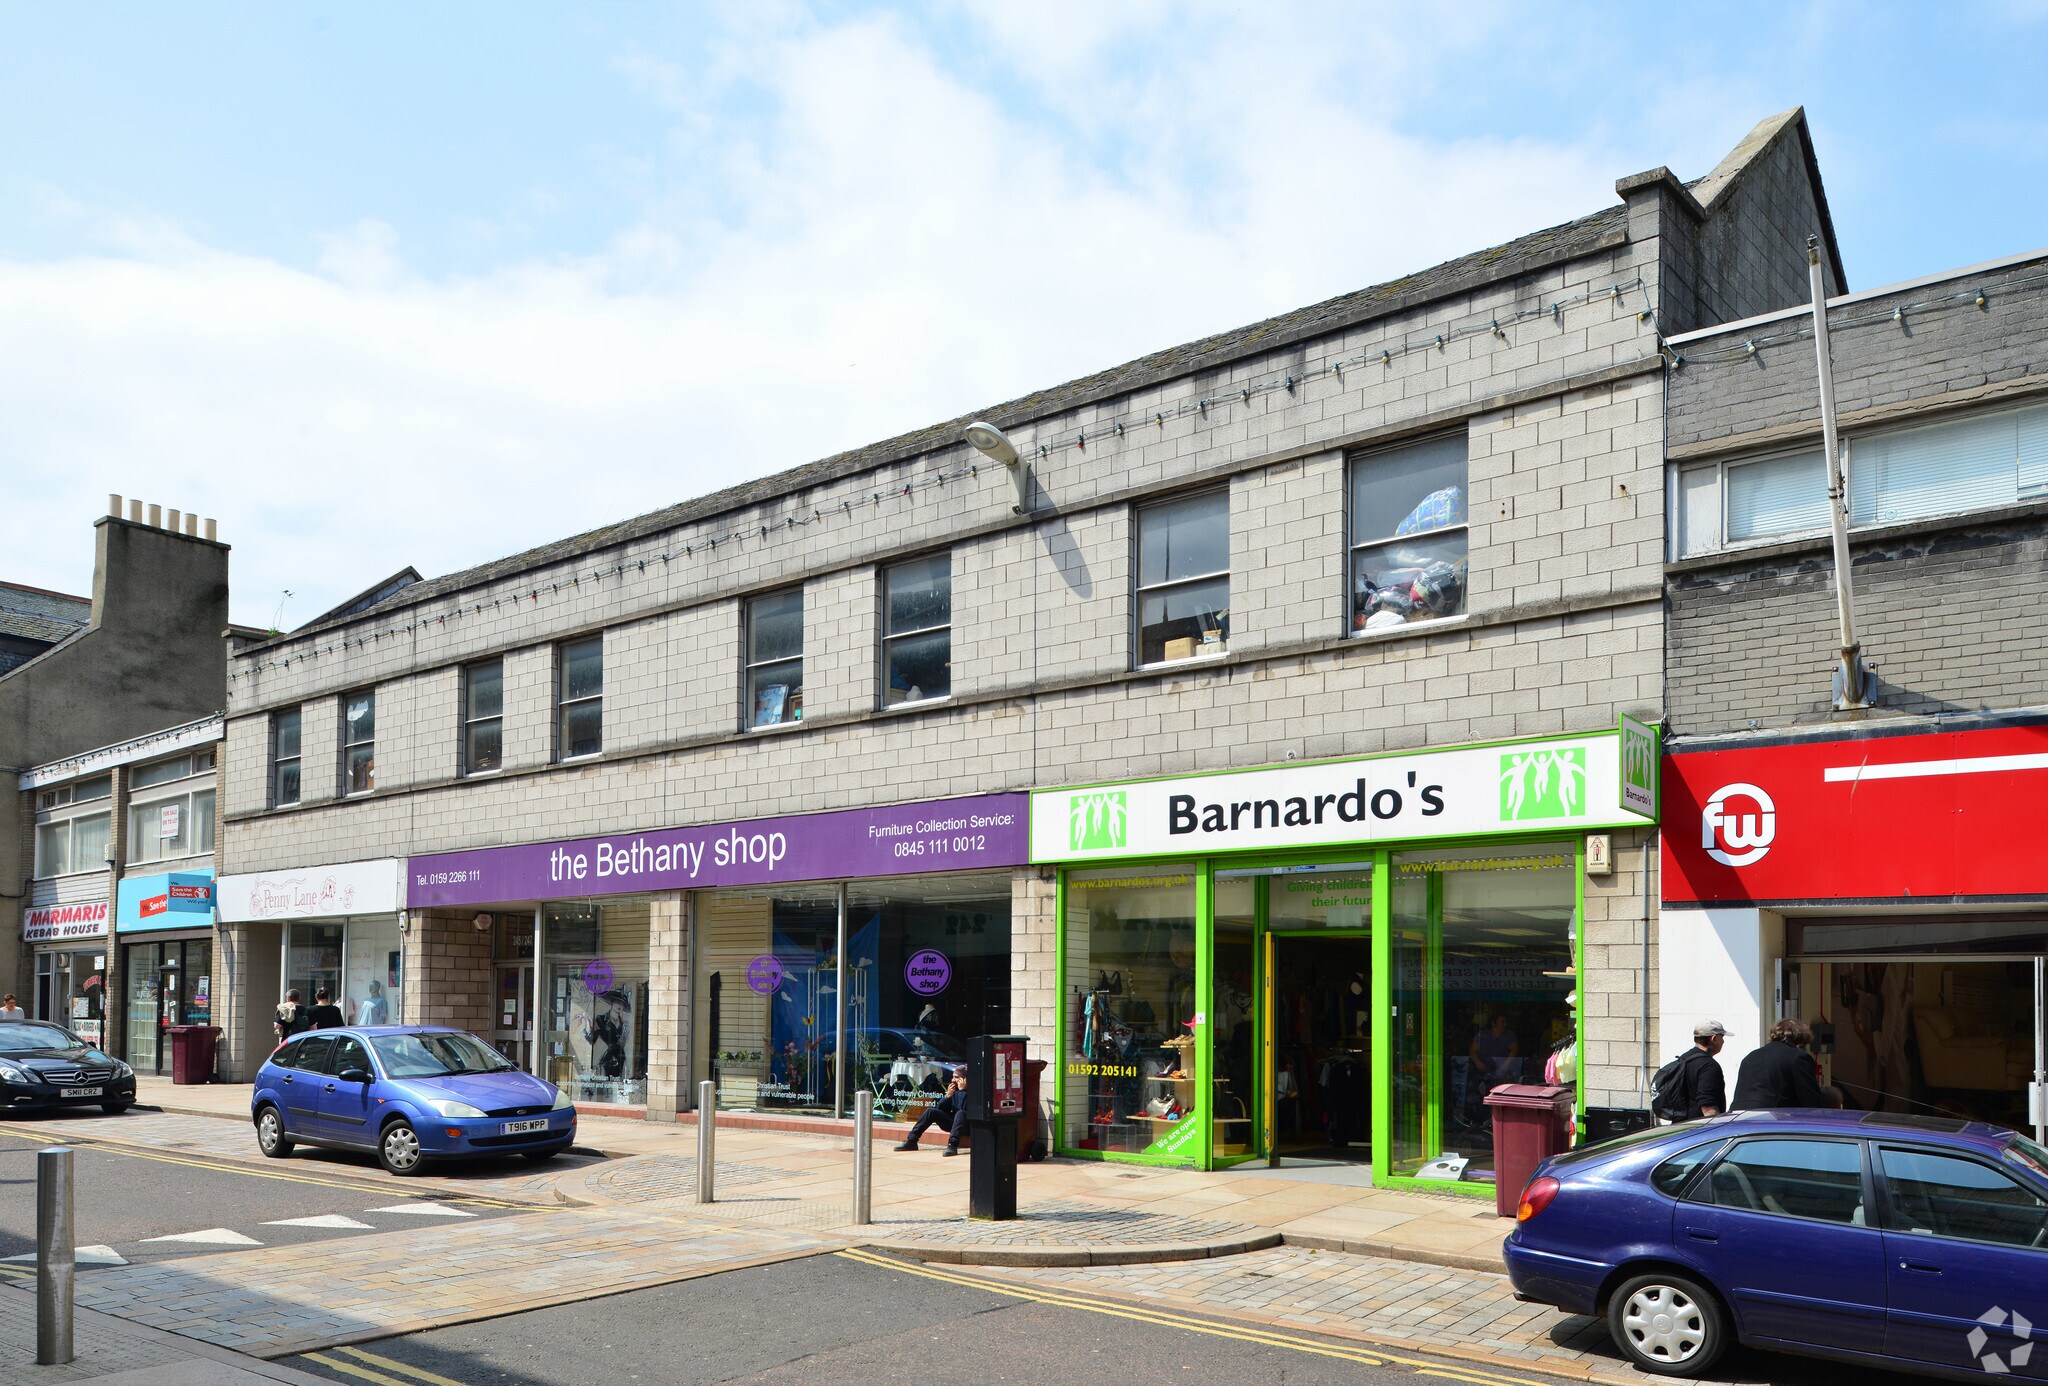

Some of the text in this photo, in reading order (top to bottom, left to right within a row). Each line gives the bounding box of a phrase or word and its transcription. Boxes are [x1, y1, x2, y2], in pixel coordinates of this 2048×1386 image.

[1168, 770, 1445, 836] Barnardo's
[1626, 787, 1652, 806] Barnardo's
[869, 813, 1015, 838] Furniture Collection Service:
[894, 835, 985, 857] 0845 111 0012
[551, 828, 786, 881] the Bethany shop
[1400, 853, 1565, 873] www.barnardos.org.uk
[416, 870, 481, 886] Tel. 0159 2266 111
[1071, 873, 1189, 890] www.barnardos.org.uk
[1287, 881, 1324, 895] Giving
[150, 901, 160, 911] Save
[264, 887, 318, 910] Penny Lane
[1312, 895, 1371, 908] their futur
[30, 903, 108, 927] MARMARIS
[26, 923, 99, 939] KEBAB HOUSE
[922, 954, 937, 964] the
[911, 966, 945, 978] Bethany
[919, 979, 939, 989] shop
[1068, 1063, 1138, 1077] 01592 205141
[67, 1088, 98, 1097] SM11 CRZ
[756, 1081, 777, 1090] Christian
[778, 1082, 791, 1091] Trust
[893, 1088, 917, 1099] Bethany
[917, 1090, 944, 1099] Christian
[771, 1091, 797, 1099] vulnerable
[797, 1093, 815, 1101] people
[924, 1100, 936, 1108] and
[508, 1121, 528, 1133] T916
[1156, 1116, 1197, 1149] We are open
[1167, 1129, 1197, 1153] Sundays
